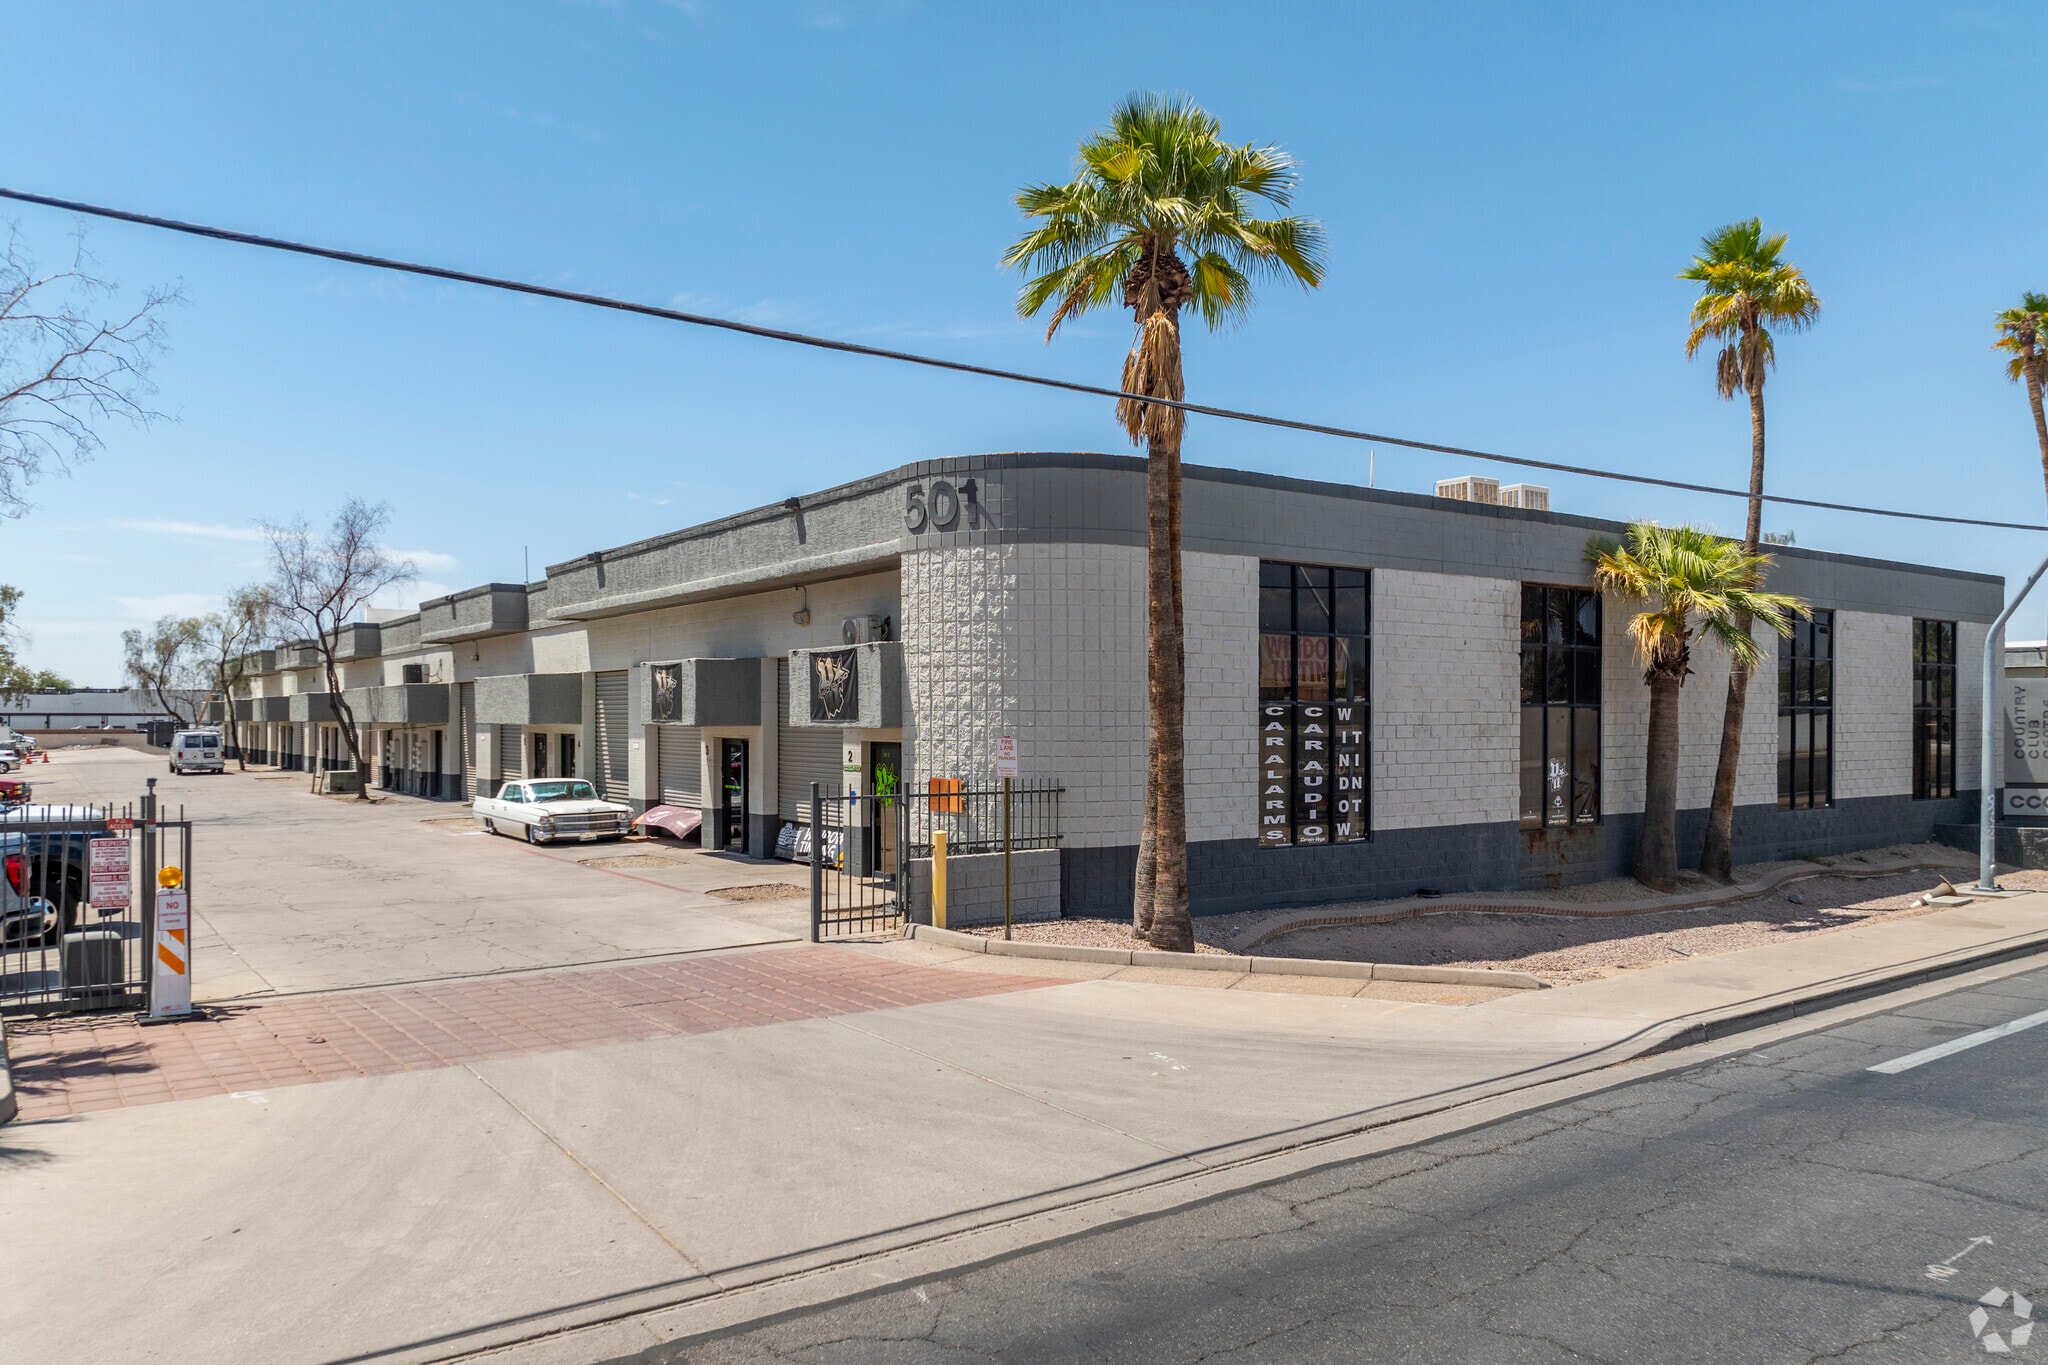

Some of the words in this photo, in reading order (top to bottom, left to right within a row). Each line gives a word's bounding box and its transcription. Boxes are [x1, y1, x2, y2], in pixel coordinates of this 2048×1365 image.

[904, 479, 978, 529] 501
[2014, 686, 2026, 759] COUNTRY
[2028, 719, 2040, 759] CLUB
[848, 750, 853, 763] 2
[166, 901, 179, 909] NO
